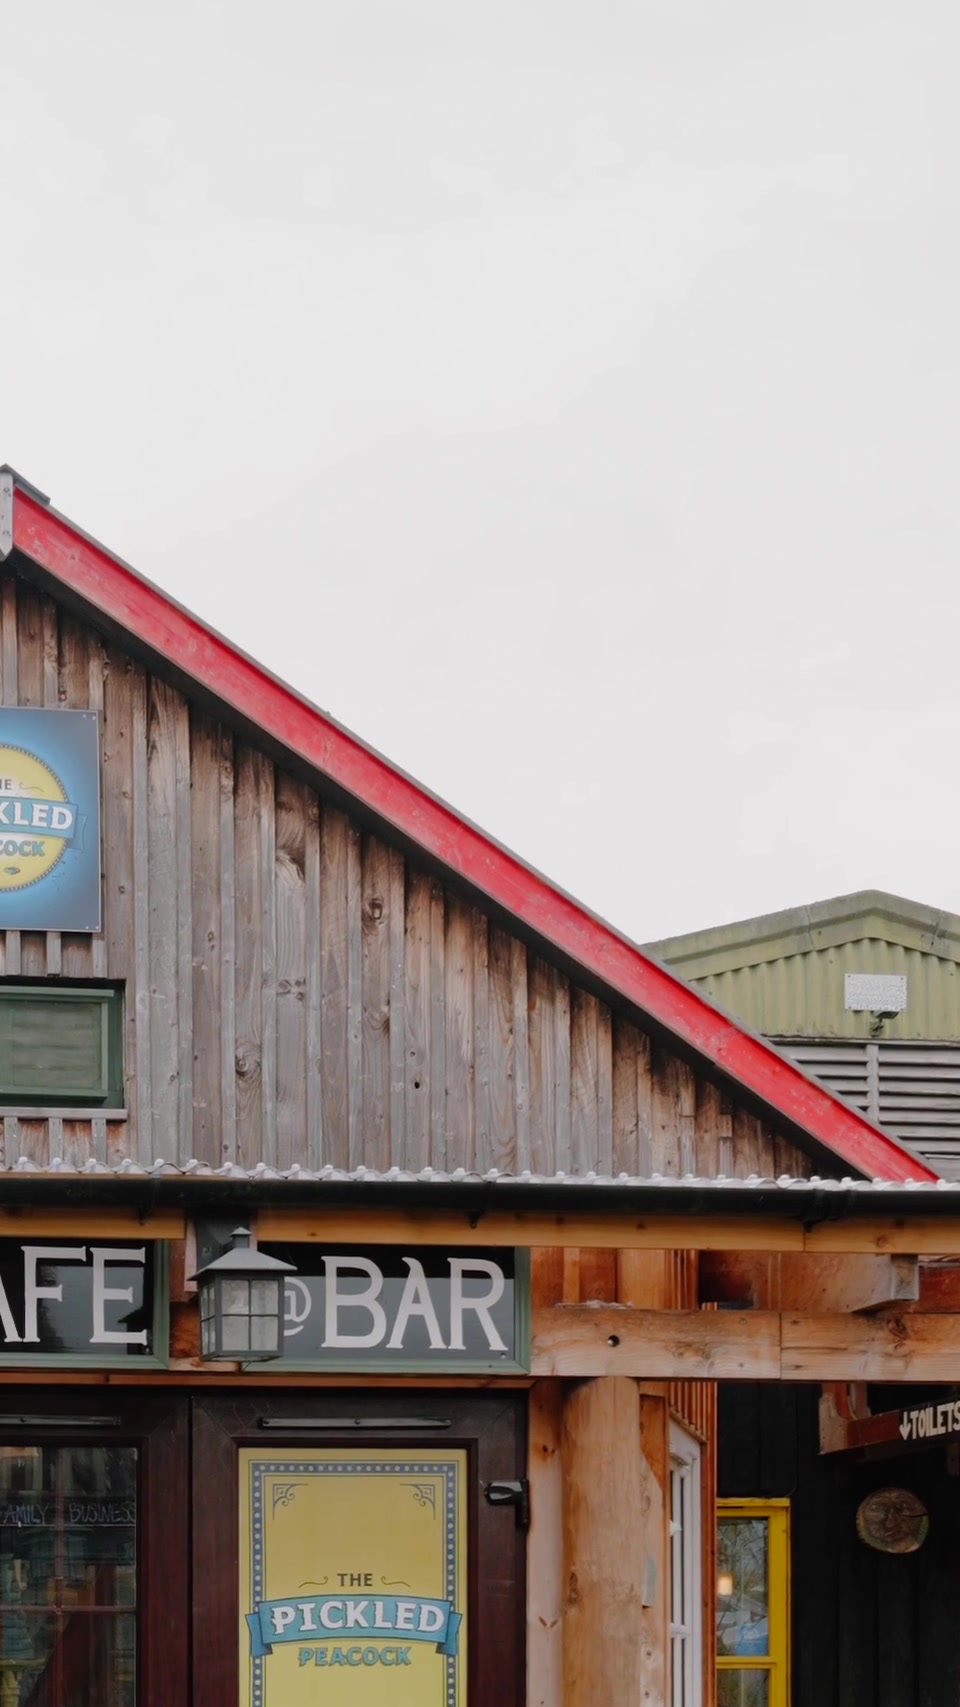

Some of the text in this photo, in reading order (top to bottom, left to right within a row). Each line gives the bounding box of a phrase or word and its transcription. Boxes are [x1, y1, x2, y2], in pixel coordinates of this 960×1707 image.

[321, 1256, 508, 1350] BAR
[909, 1400, 960, 1440] TOILETS
[337, 1573, 373, 1587] THE
[270, 1600, 445, 1636] PICKLED
[298, 1646, 412, 1667] PEACOCK
